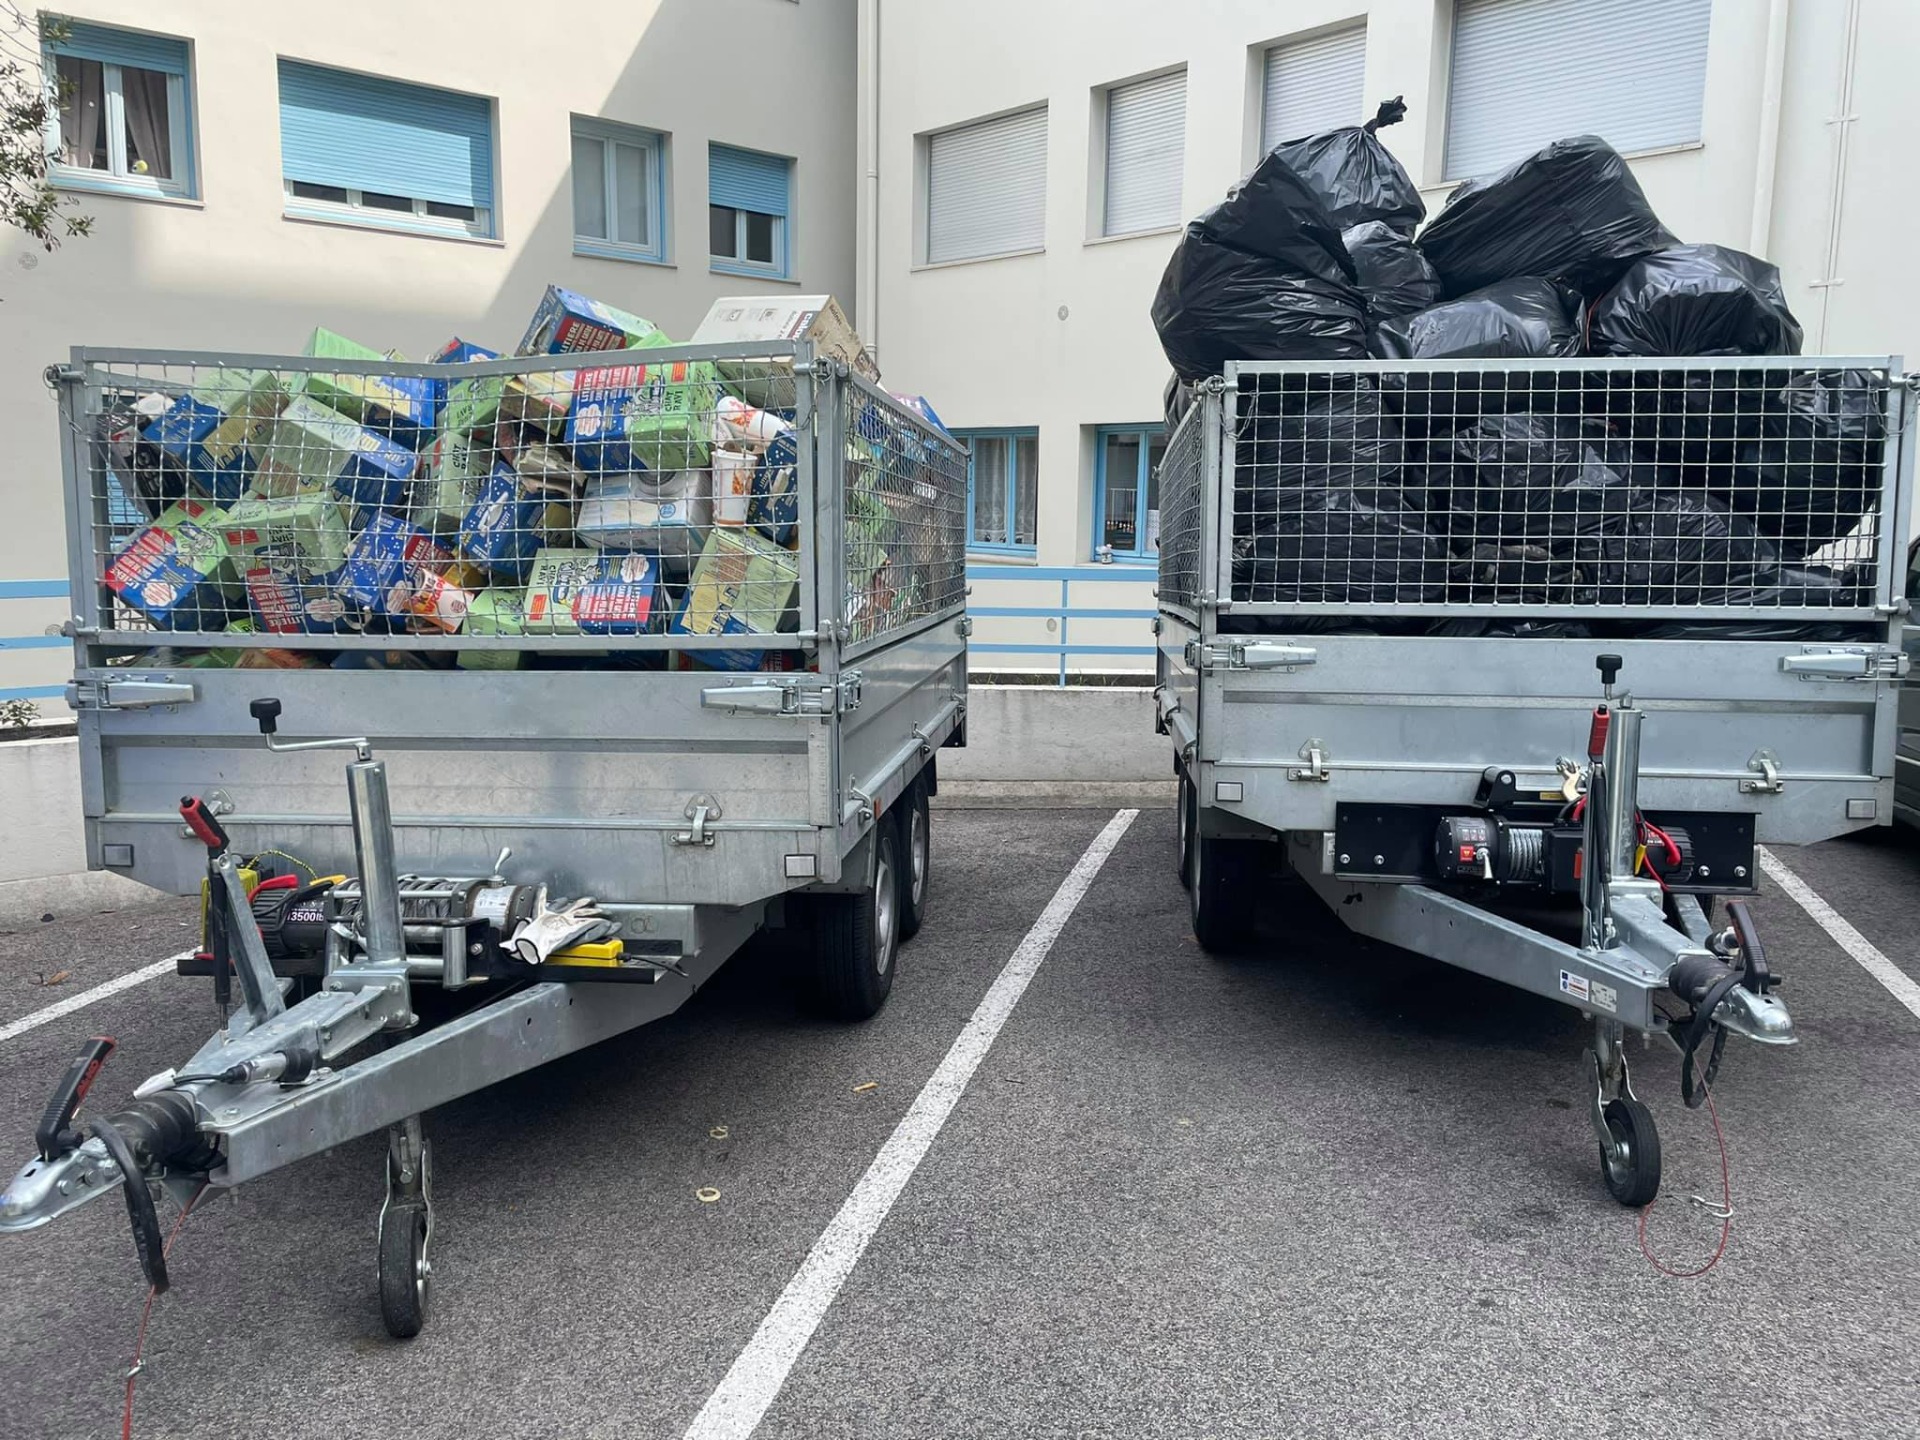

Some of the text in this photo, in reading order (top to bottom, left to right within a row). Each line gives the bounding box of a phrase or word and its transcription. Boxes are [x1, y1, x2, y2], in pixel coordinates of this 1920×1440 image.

[559, 320, 580, 353] LITIERE
[664, 390, 675, 412] CHAT
[672, 390, 683, 411] RAVI
